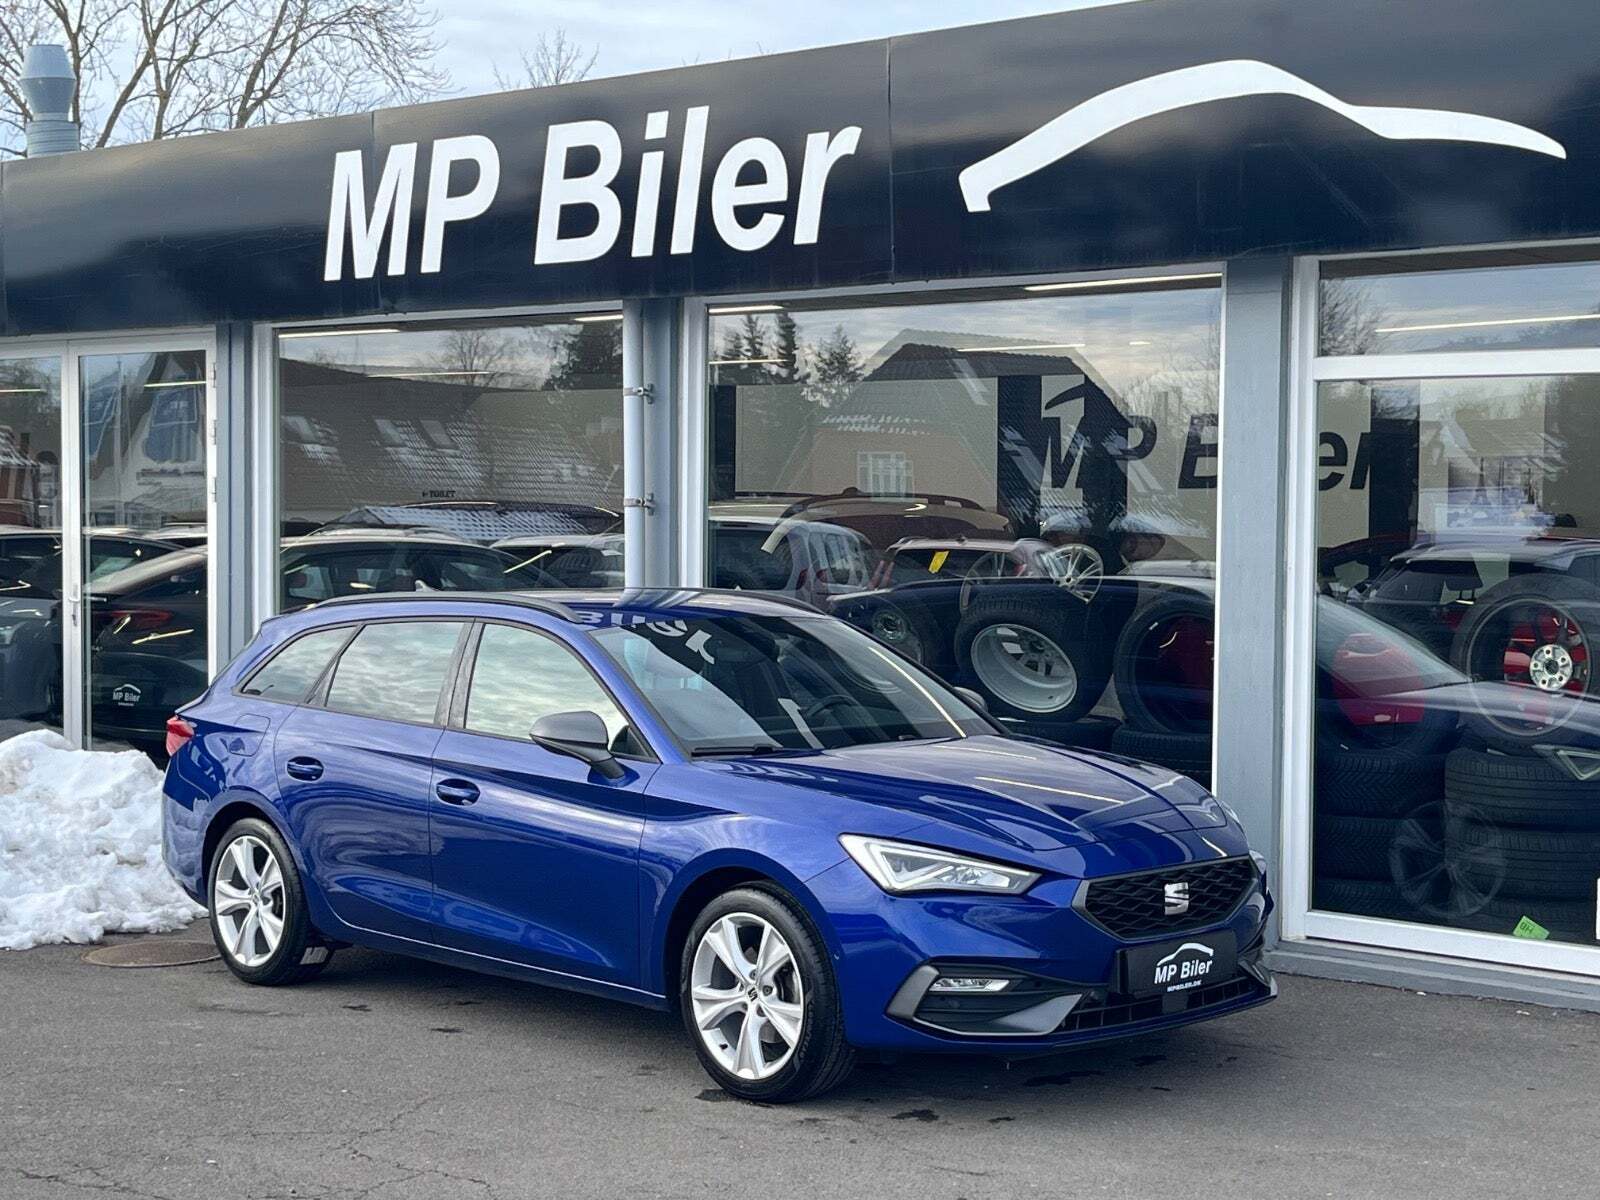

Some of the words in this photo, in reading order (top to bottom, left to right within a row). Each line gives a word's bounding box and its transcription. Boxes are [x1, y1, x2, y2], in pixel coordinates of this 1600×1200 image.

[323, 134, 501, 282] MP
[533, 104, 863, 266] Biler
[1154, 964, 1178, 985] MP
[1180, 959, 1213, 979] Biler
